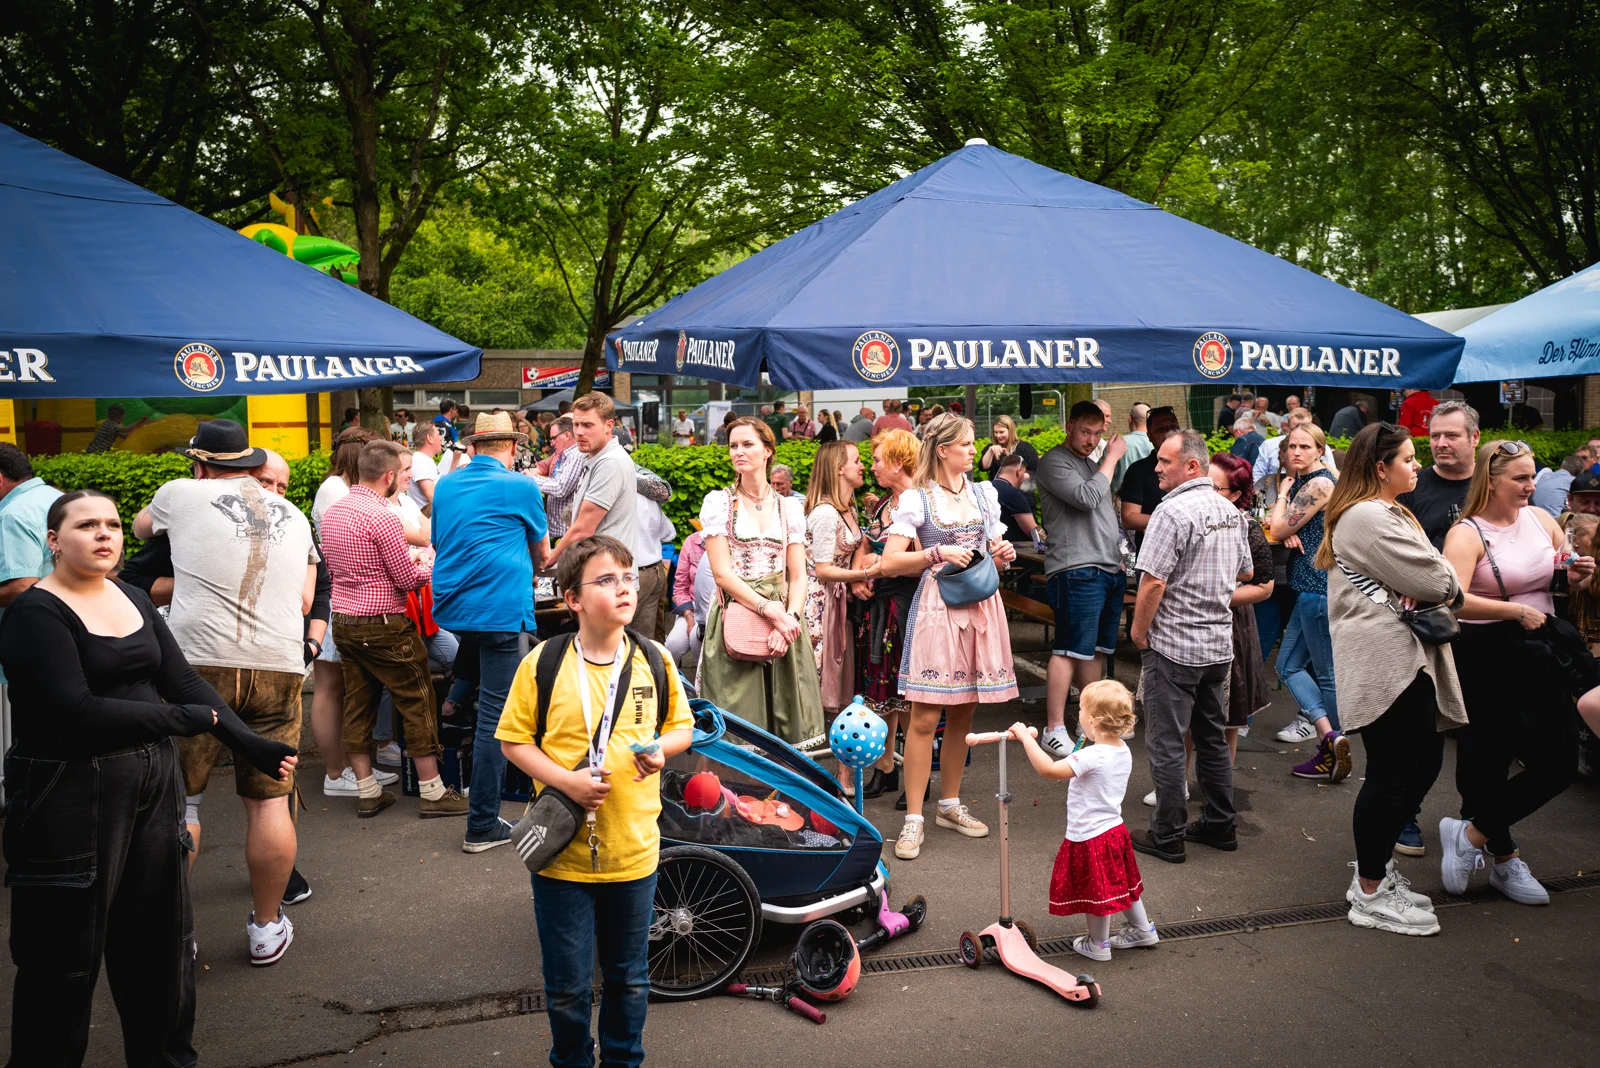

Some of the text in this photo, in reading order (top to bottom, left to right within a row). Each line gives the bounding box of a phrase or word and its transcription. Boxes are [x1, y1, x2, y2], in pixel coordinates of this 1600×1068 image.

[177, 345, 219, 363] PAULANER
[622, 338, 659, 363] PAULANER
[686, 337, 736, 372] PAULANER
[855, 333, 896, 352] PAULANER
[907, 337, 1104, 370] PAULANER
[1195, 334, 1229, 350] PAULANER
[1539, 341, 1566, 364] Der
[232, 352, 425, 382] PAULANER
[1239, 340, 1402, 377] PAULANER
